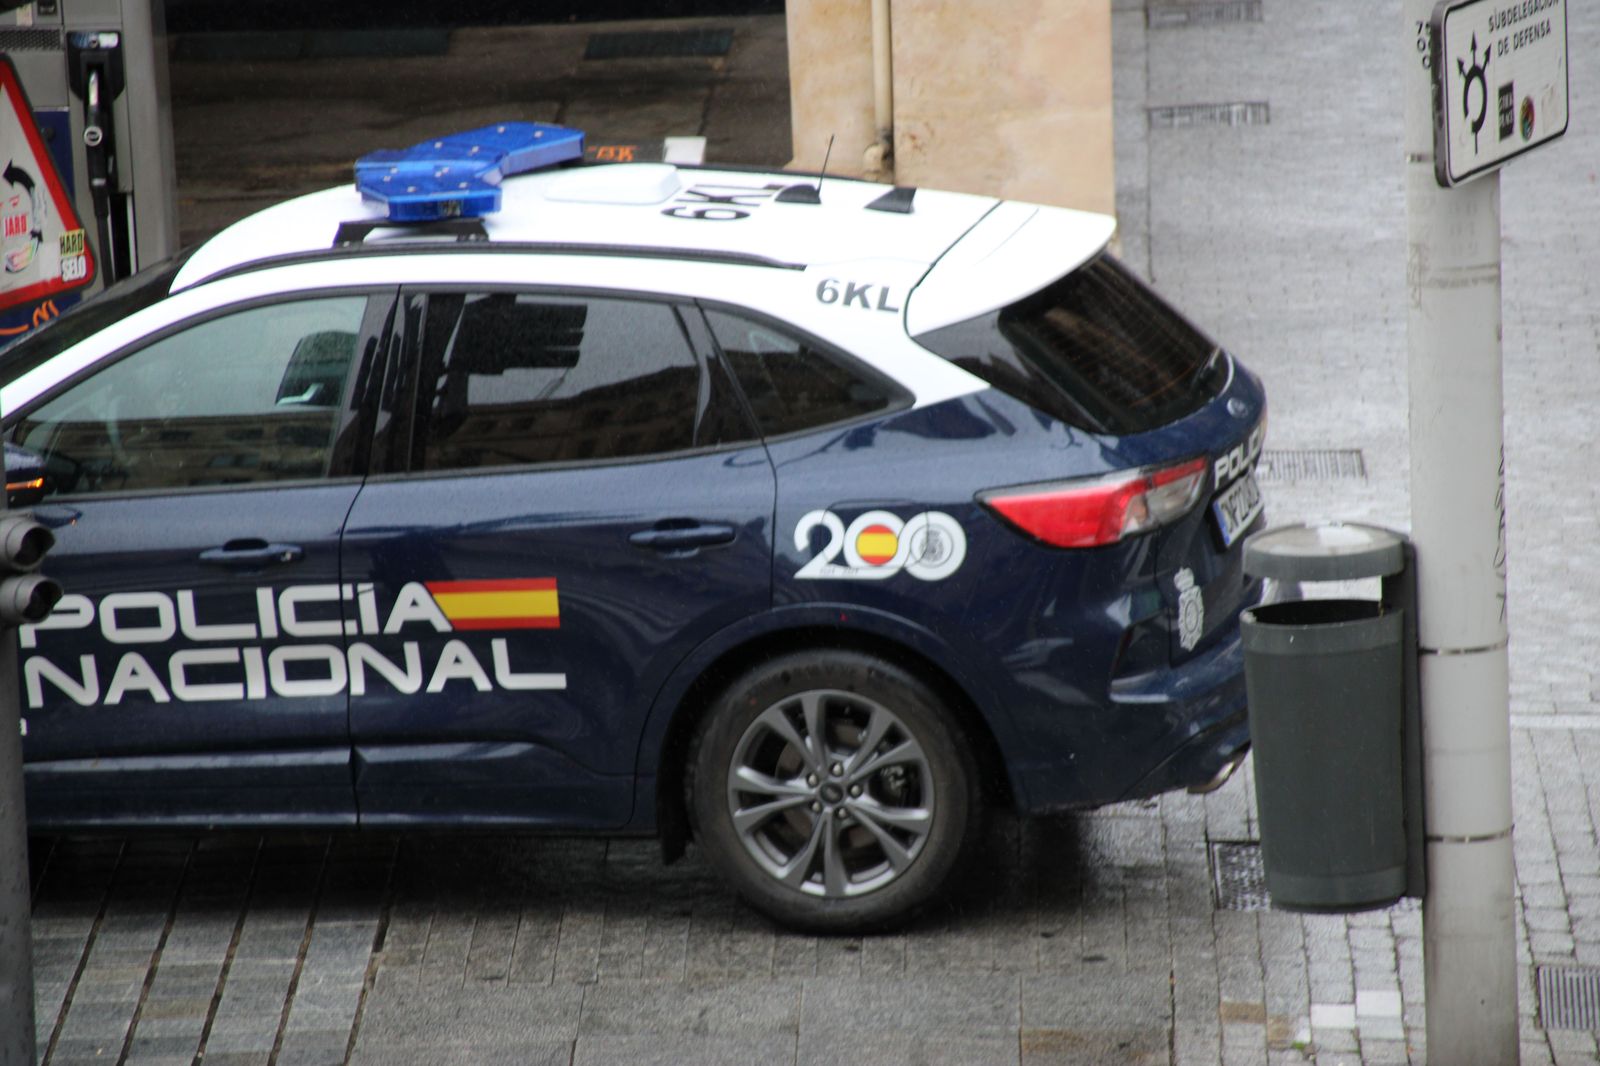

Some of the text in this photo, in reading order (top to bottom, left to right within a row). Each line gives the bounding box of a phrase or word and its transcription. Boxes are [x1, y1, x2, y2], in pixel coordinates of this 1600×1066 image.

[1497, 18, 1551, 57] DE DEFENSA
[59, 231, 84, 255] HARD
[816, 278, 899, 313] 6KL
[794, 509, 967, 581] 200
[24, 638, 568, 709] NACIONAL
